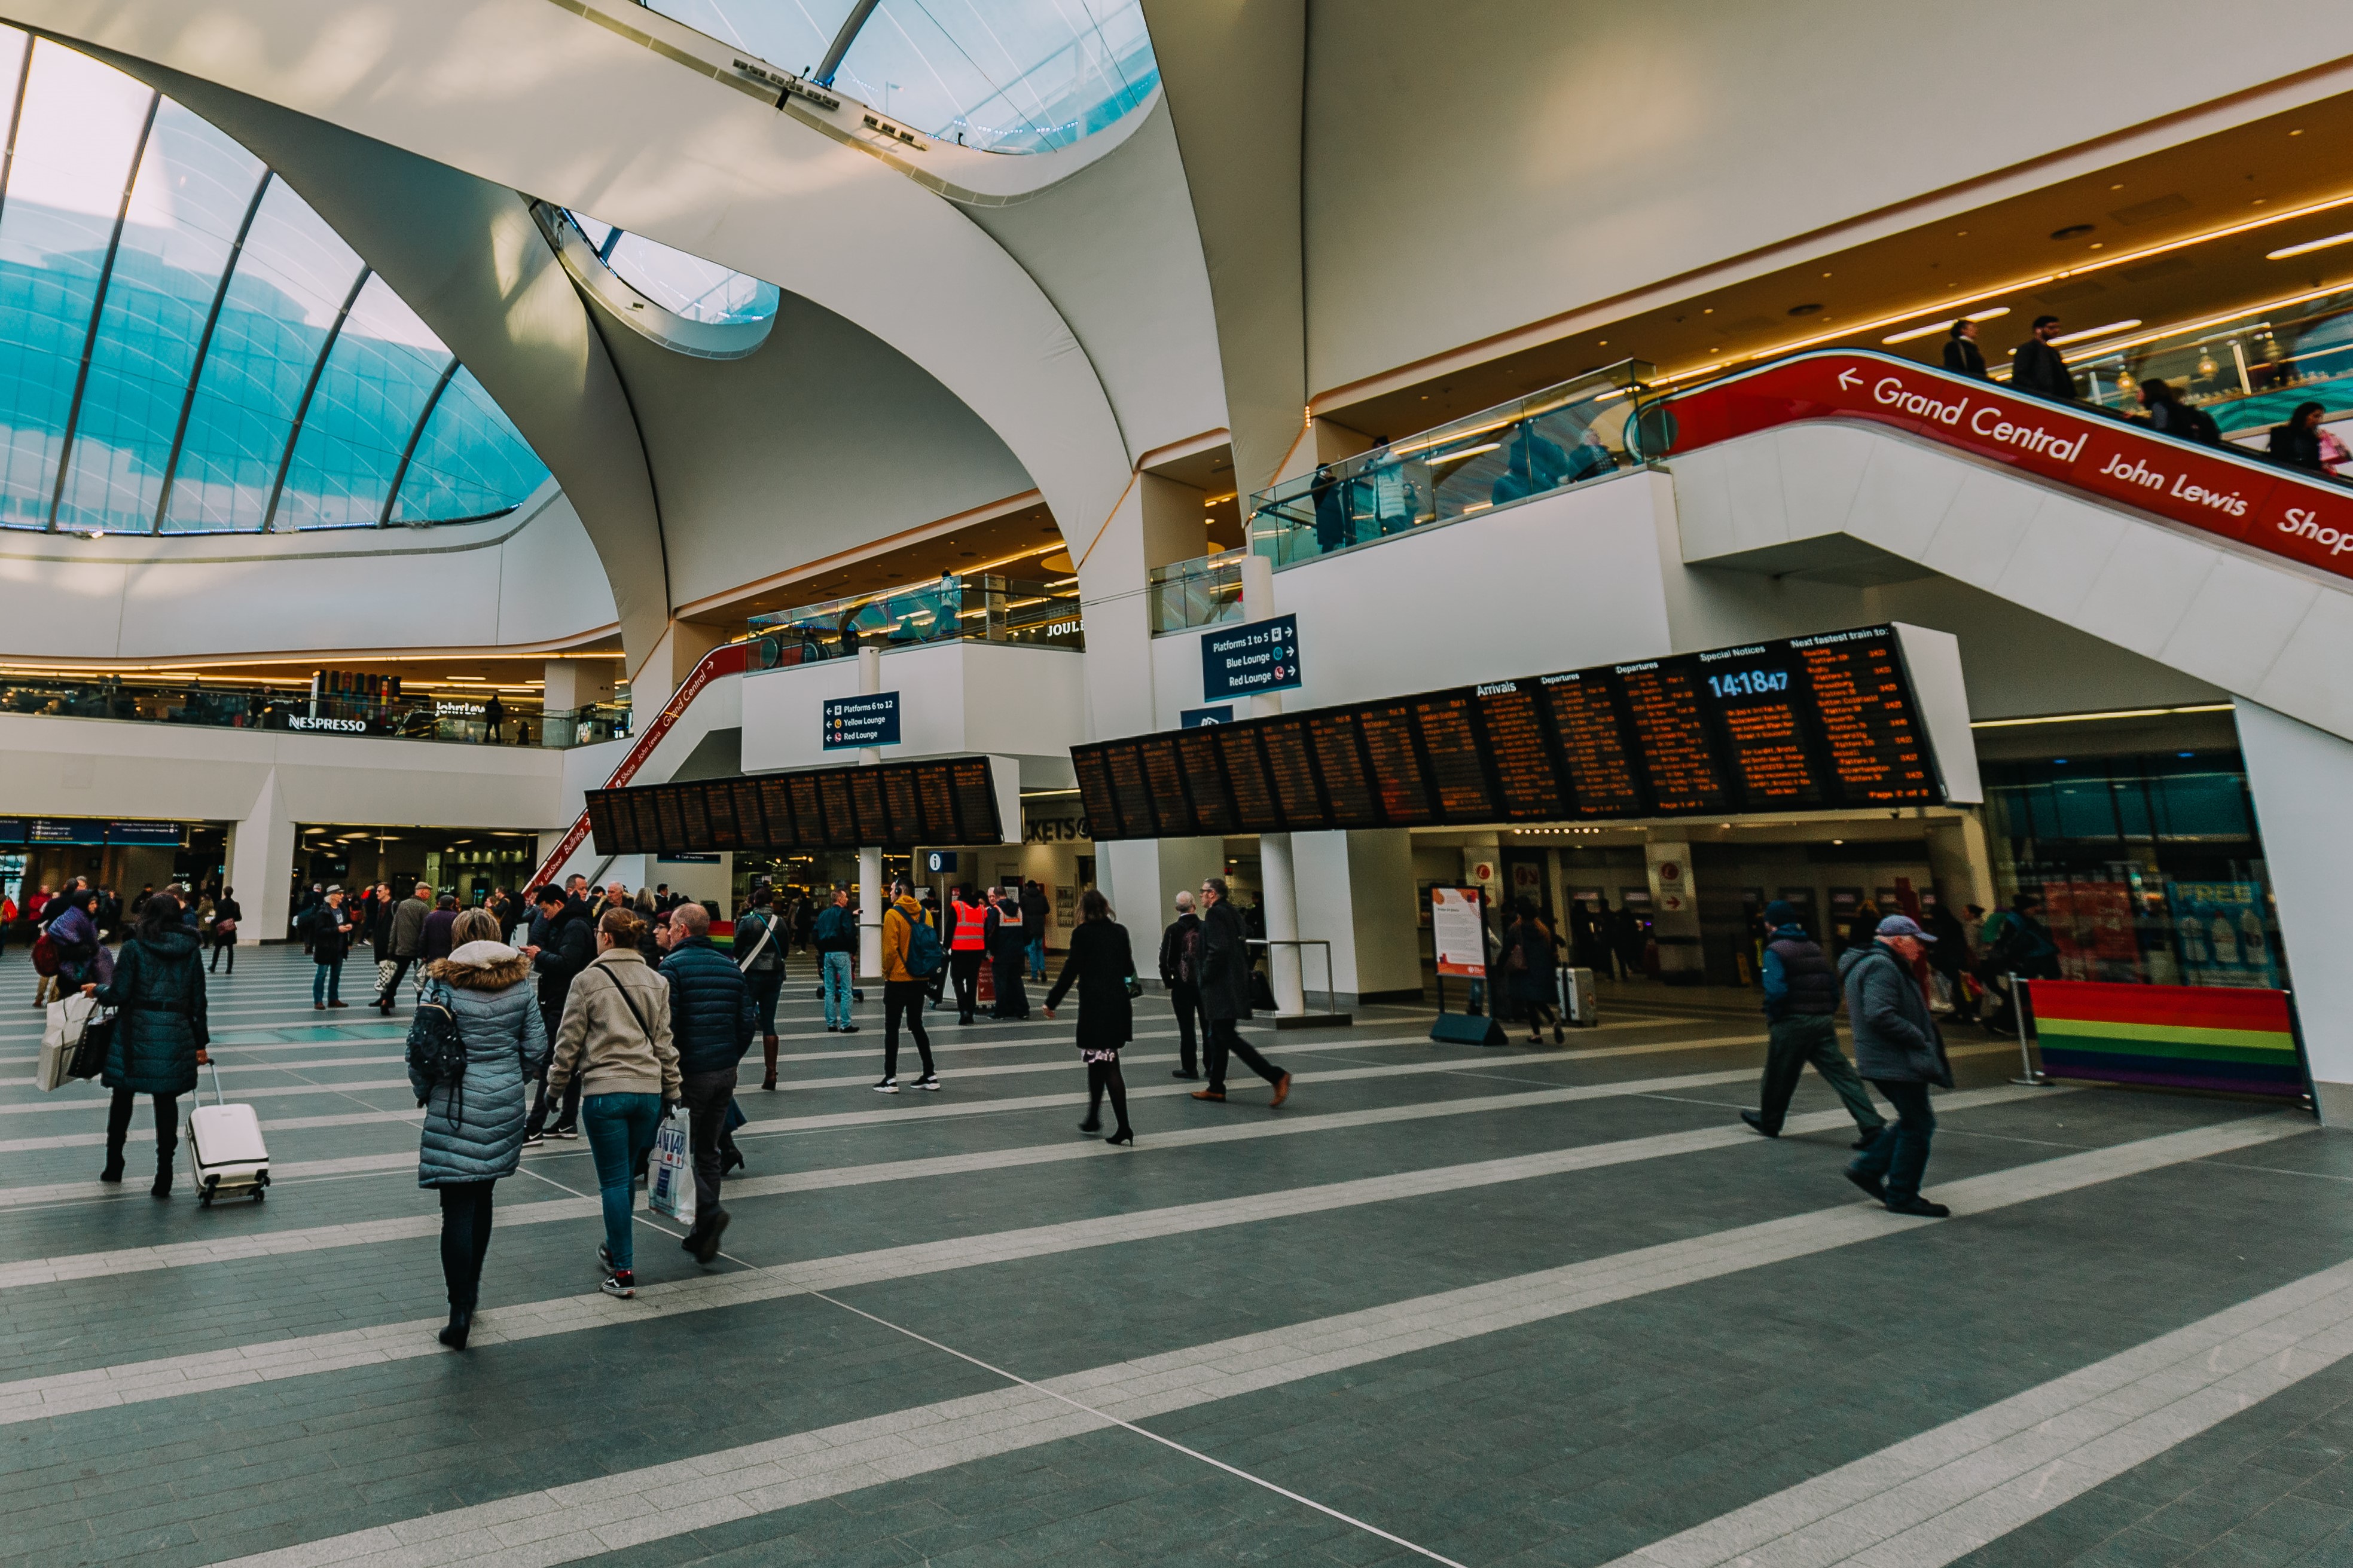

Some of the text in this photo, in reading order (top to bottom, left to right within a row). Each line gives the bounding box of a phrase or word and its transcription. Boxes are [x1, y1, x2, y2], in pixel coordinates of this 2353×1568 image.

[1873, 377, 1969, 426] Grand
[1971, 406, 2089, 463] Central
[2099, 453, 2165, 490] John
[2169, 473, 2249, 516] Lewis
[1213, 632, 1268, 653] Platforms 1 to 5
[1790, 627, 1890, 649] Next fastest train to:
[1226, 653, 1270, 669] Blue Lounge
[1699, 646, 1766, 662] Special Notices
[1616, 662, 1659, 674] Departures
[1229, 672, 1271, 687] Red Lounge
[1540, 673, 1580, 685] Departures
[1476, 681, 1516, 696] Arrivals
[435, 701, 486, 717] John Lew
[844, 704, 871, 713] Platforms
[872, 702, 877, 710] 6
[885, 700, 893, 709] 12
[289, 714, 367, 732] NESPRESSO
[621, 669, 707, 783] Shops John Lewis Grand Central
[844, 716, 886, 726] Yellow Lounge
[844, 731, 878, 741] Red Lounge
[563, 827, 585, 855] Bullring
[2176, 884, 2253, 904] FREE
